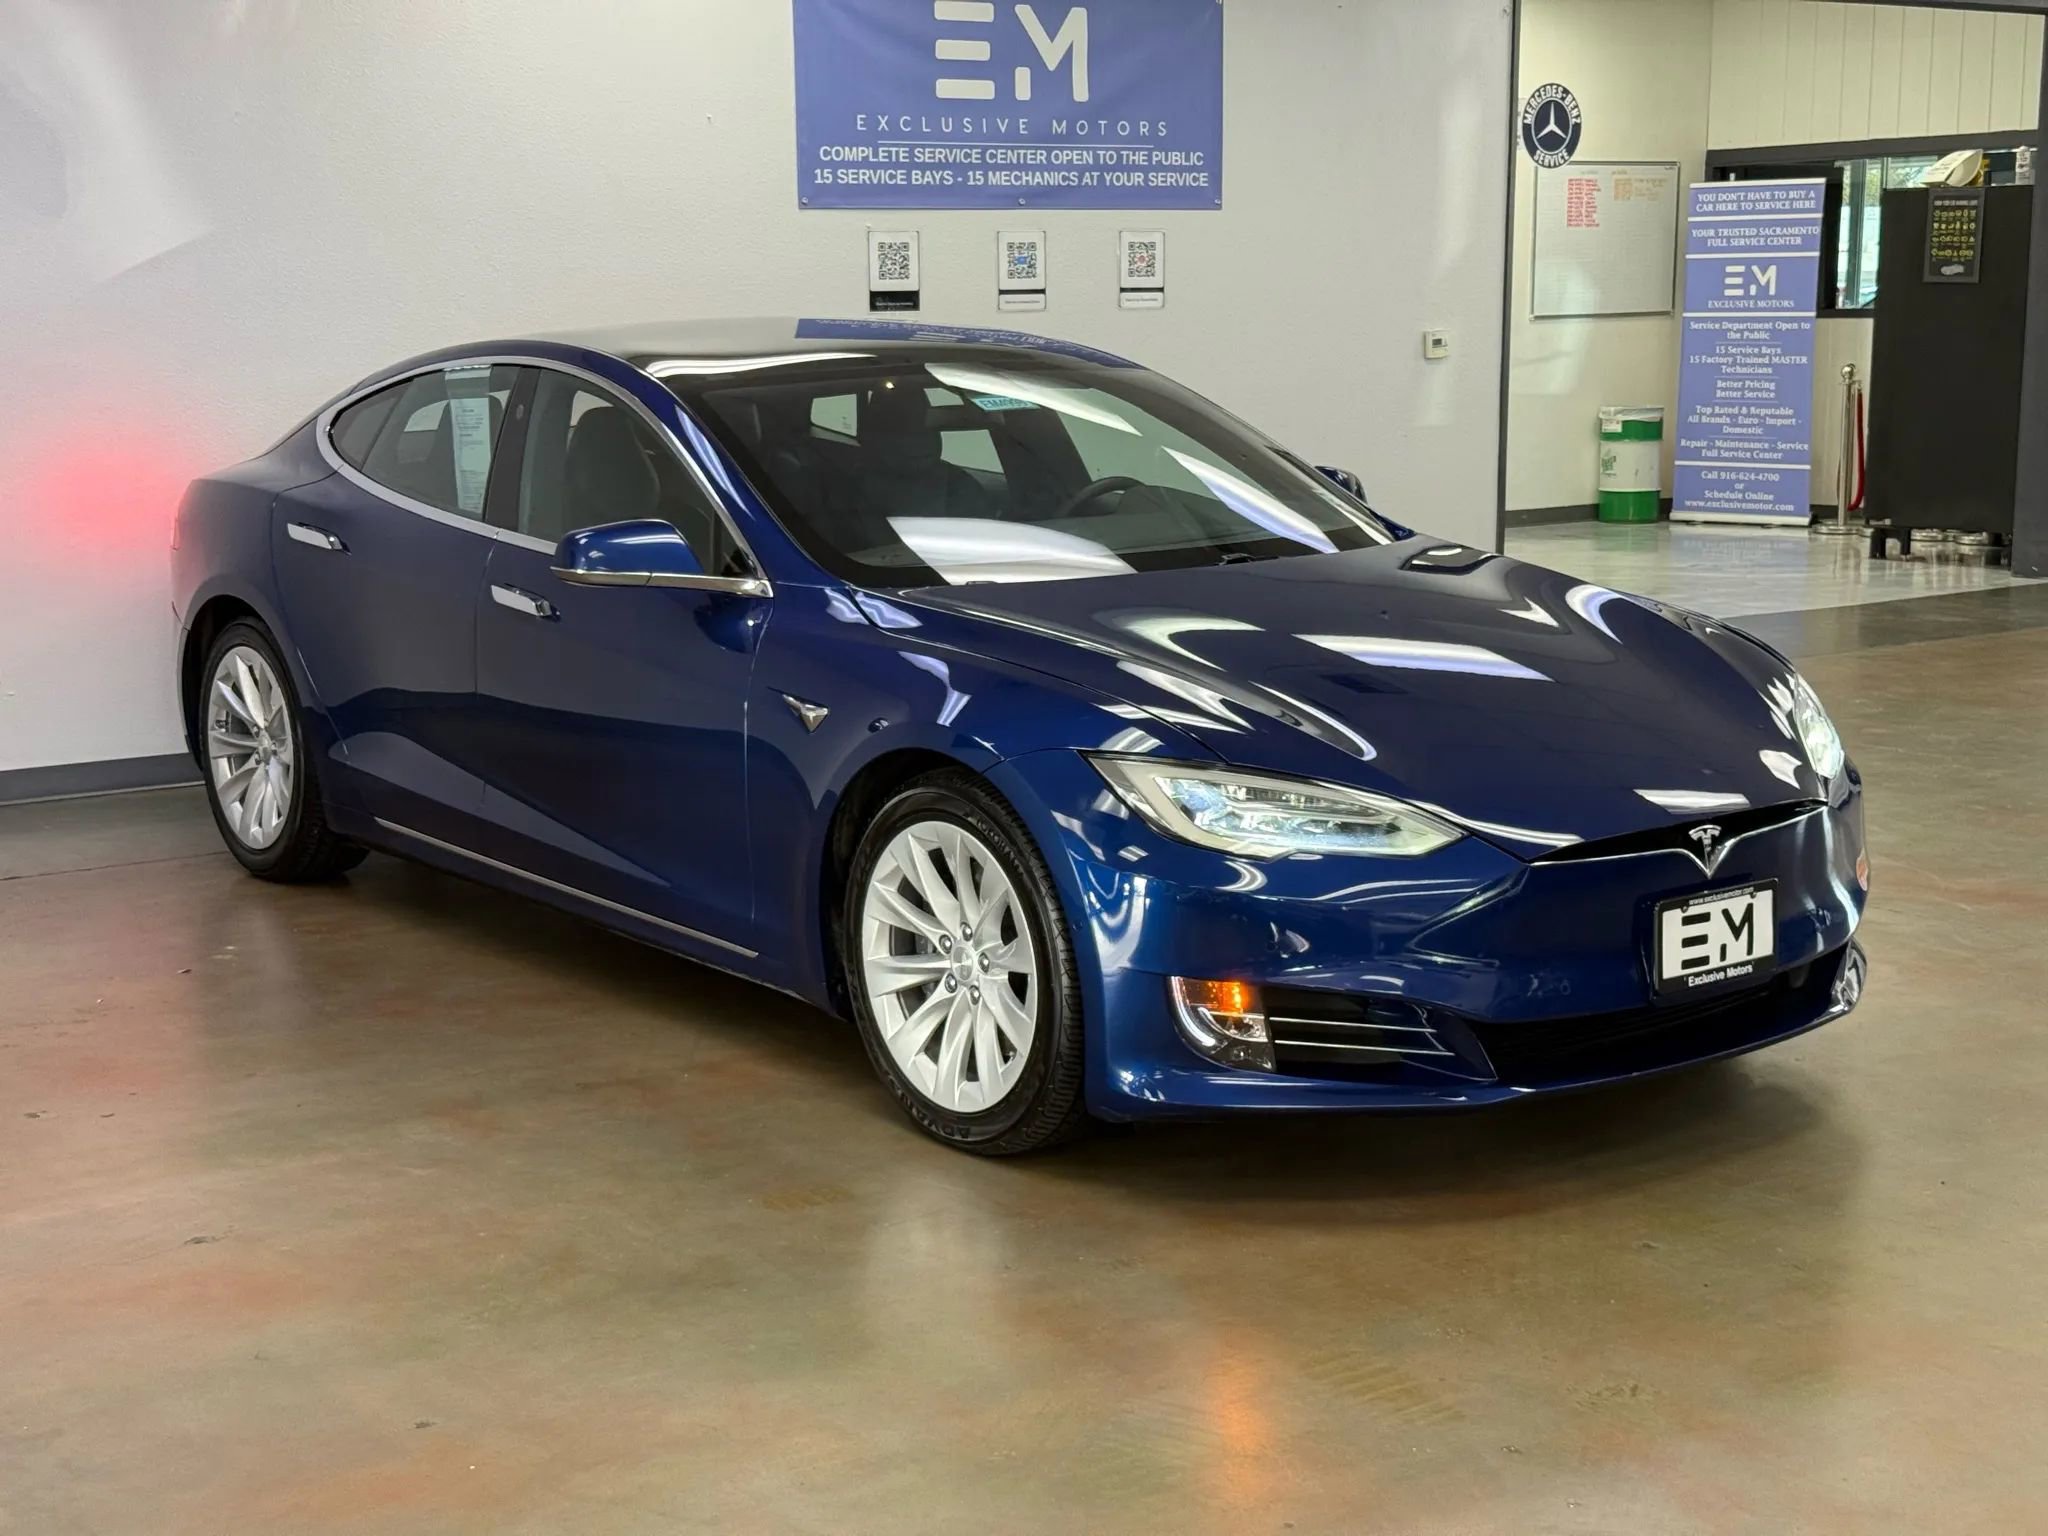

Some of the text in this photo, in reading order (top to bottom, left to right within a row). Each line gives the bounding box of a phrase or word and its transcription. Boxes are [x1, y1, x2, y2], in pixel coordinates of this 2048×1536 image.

[856, 114, 1168, 137] EXCLUSIVE MOTORS
[819, 146, 1204, 166] COMPLETE SERVICE CENTER OPEN TO THE PUBLIC
[1533, 149, 1570, 167] SERVICE
[814, 168, 833, 184] 15
[837, 169, 907, 185] SERVICE
[911, 170, 954, 185] BAYS
[967, 171, 985, 186] 15
[988, 171, 1078, 186] MECHANICS
[1081, 171, 1100, 186] AT
[1103, 172, 1145, 187] YOUR
[1149, 172, 1209, 187] SERVICE
[1698, 190, 1815, 202] YOU DON'T HAVE TO BUY A
[1696, 200, 1816, 212] CAR HERE TO SERVICE HERE
[1692, 226, 1820, 237] YOUR TRUSTED SACRAMENTO
[1707, 236, 1802, 247] FULL SERVICE CENTER
[1708, 300, 1794, 308] EXCLUSIVE MOTORS
[1690, 321, 1720, 330] Service
[1722, 321, 1773, 331] Department
[1775, 321, 1798, 331] Open
[1727, 331, 1771, 340] the Public
[1715, 345, 1782, 355] 15 Service Bays
[1689, 355, 1808, 365] 15 Factory Trained MASTER
[1721, 365, 1772, 374] Technicians
[1716, 380, 1776, 390] Better Pricing
[1716, 390, 1775, 398] Better Service
[1695, 405, 1712, 415] Top
[1714, 405, 1738, 414] Rated
[1750, 406, 1794, 416] Reputable
[1687, 415, 1699, 423] All
[1701, 415, 1731, 424] Brands
[1738, 416, 1758, 424] Euro
[1765, 417, 1796, 426] Import
[1722, 425, 1764, 434] Domestic
[1680, 438, 1708, 448] Repair
[1715, 440, 1769, 449] Maintenance
[1776, 441, 1809, 450] Service
[1701, 449, 1783, 460] Full Service Center
[1701, 470, 1718, 479] Call
[1704, 490, 1774, 501] Schedule Online
[1685, 500, 1794, 511] www.exclusivemotor.com
[1688, 964, 1753, 987] Exclusive Motors
